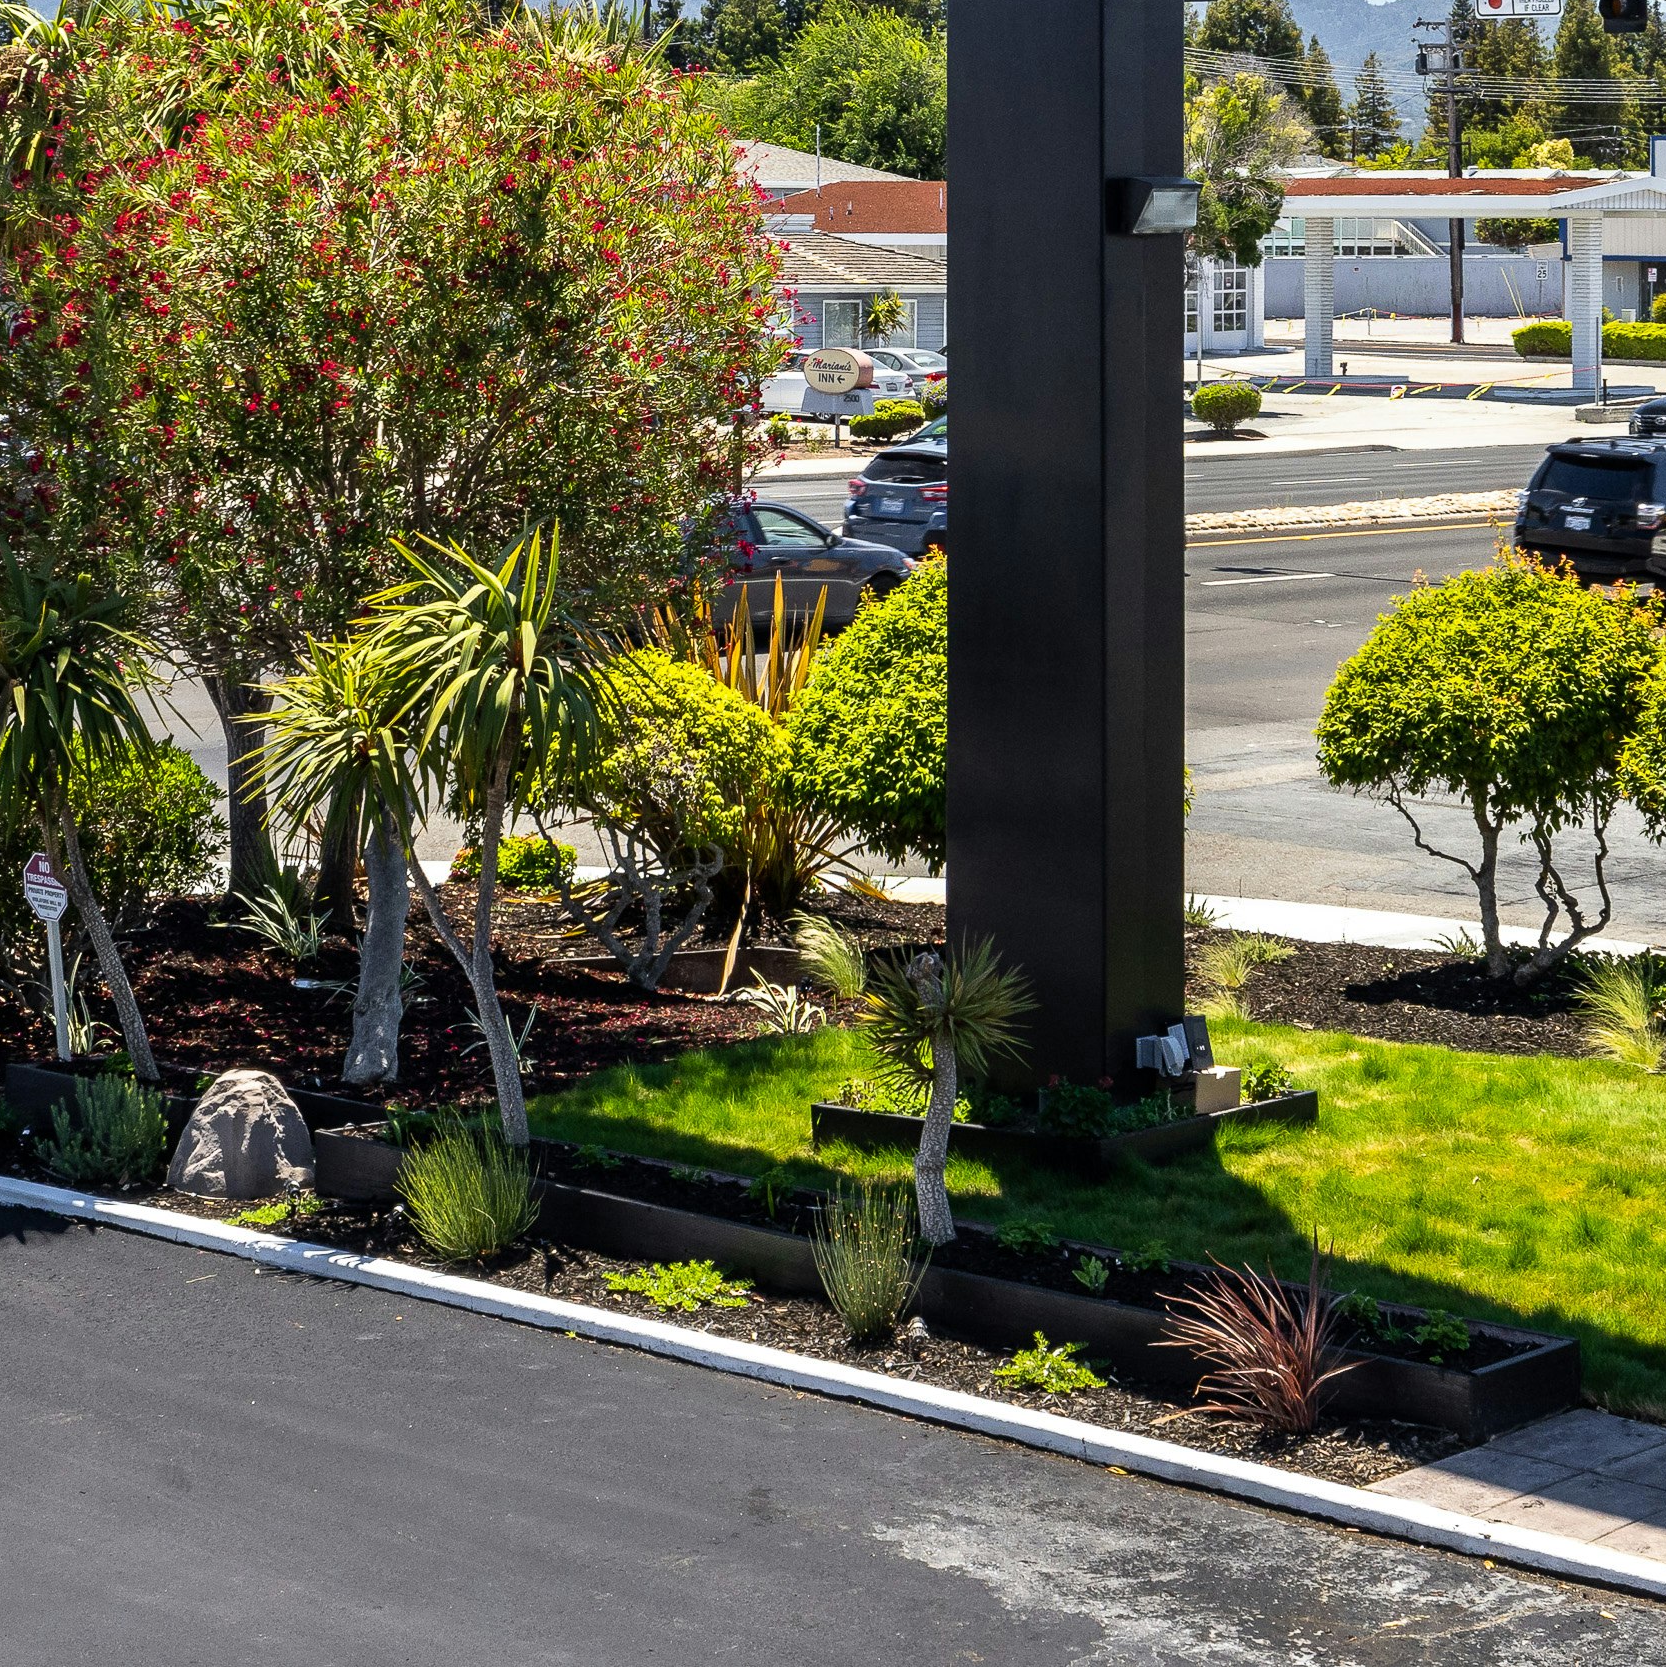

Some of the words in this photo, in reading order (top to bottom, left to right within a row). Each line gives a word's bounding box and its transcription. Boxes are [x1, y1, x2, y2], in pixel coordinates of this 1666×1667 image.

[1532, 3, 1550, 12] CLEAR
[1537, 270, 1547, 279] 25
[818, 372, 835, 383] INN
[843, 394, 860, 403] 2500
[38, 860, 50, 874] NO
